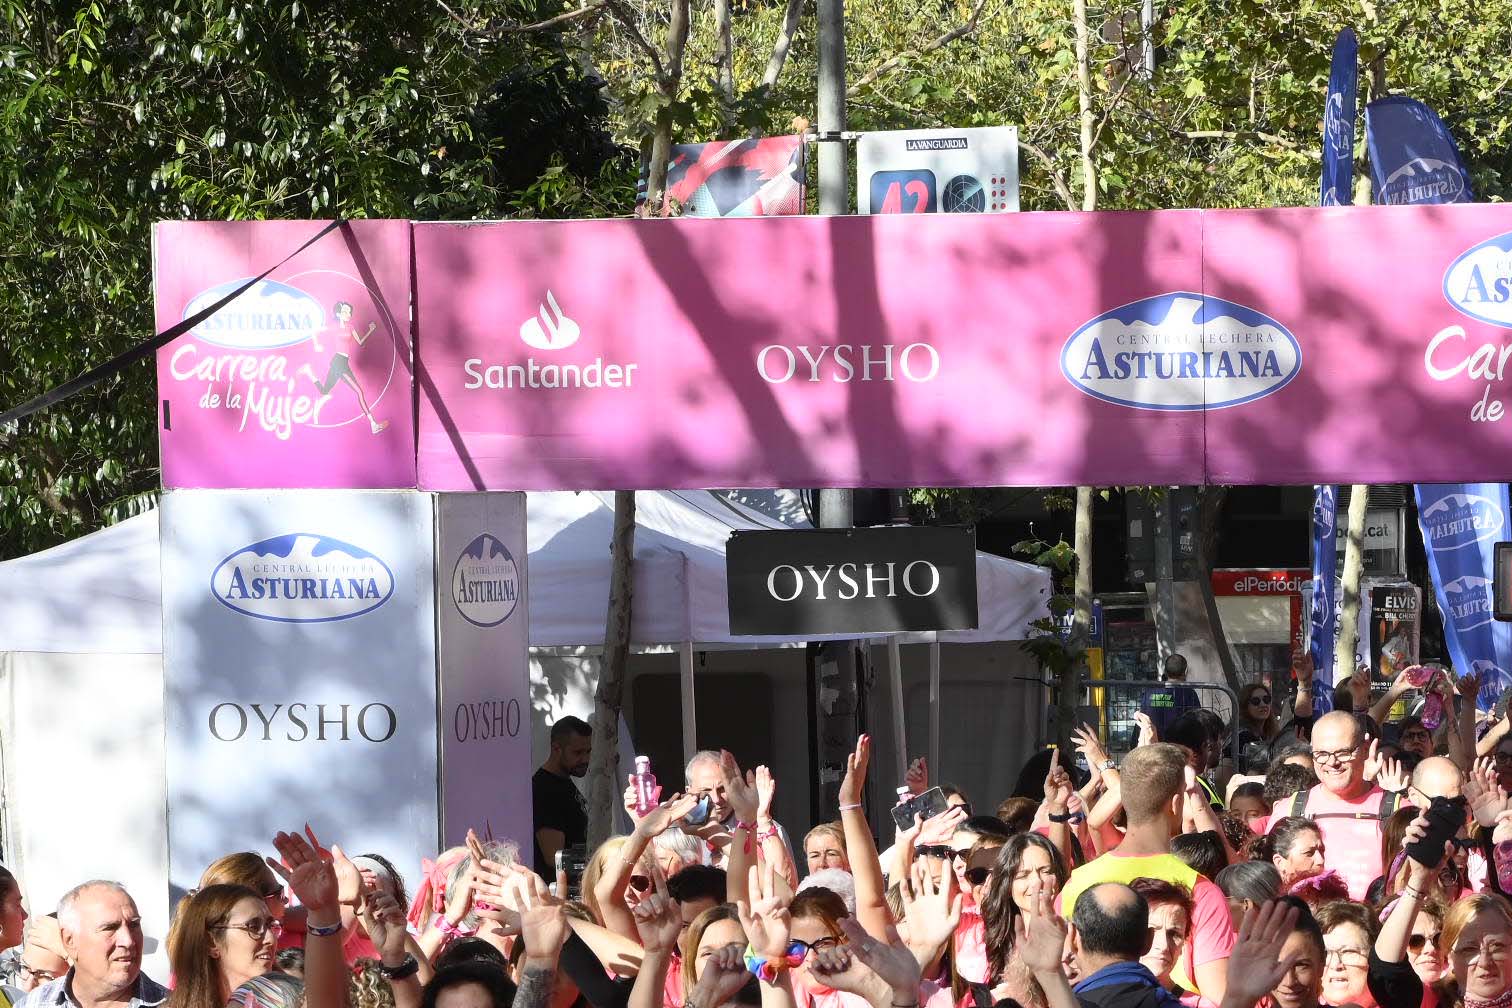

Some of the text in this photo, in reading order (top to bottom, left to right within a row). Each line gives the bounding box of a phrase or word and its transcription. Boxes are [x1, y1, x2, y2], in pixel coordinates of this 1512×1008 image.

[918, 137, 967, 149] VANGUARDIA
[170, 343, 288, 382] Carrera
[464, 358, 638, 390] Santander
[757, 343, 940, 383] OYSHO
[1080, 336, 1283, 380] ASTURIANA
[200, 383, 221, 409] de
[239, 379, 333, 441] Mujer
[1470, 384, 1505, 424] de
[225, 566, 381, 600] ASTURIANA
[457, 569, 516, 604] ASTURIANA
[767, 560, 940, 602] OYSHO
[1385, 596, 1416, 609] ELVIS
[208, 702, 397, 743] OYSHO
[454, 698, 521, 743] OYSHO
